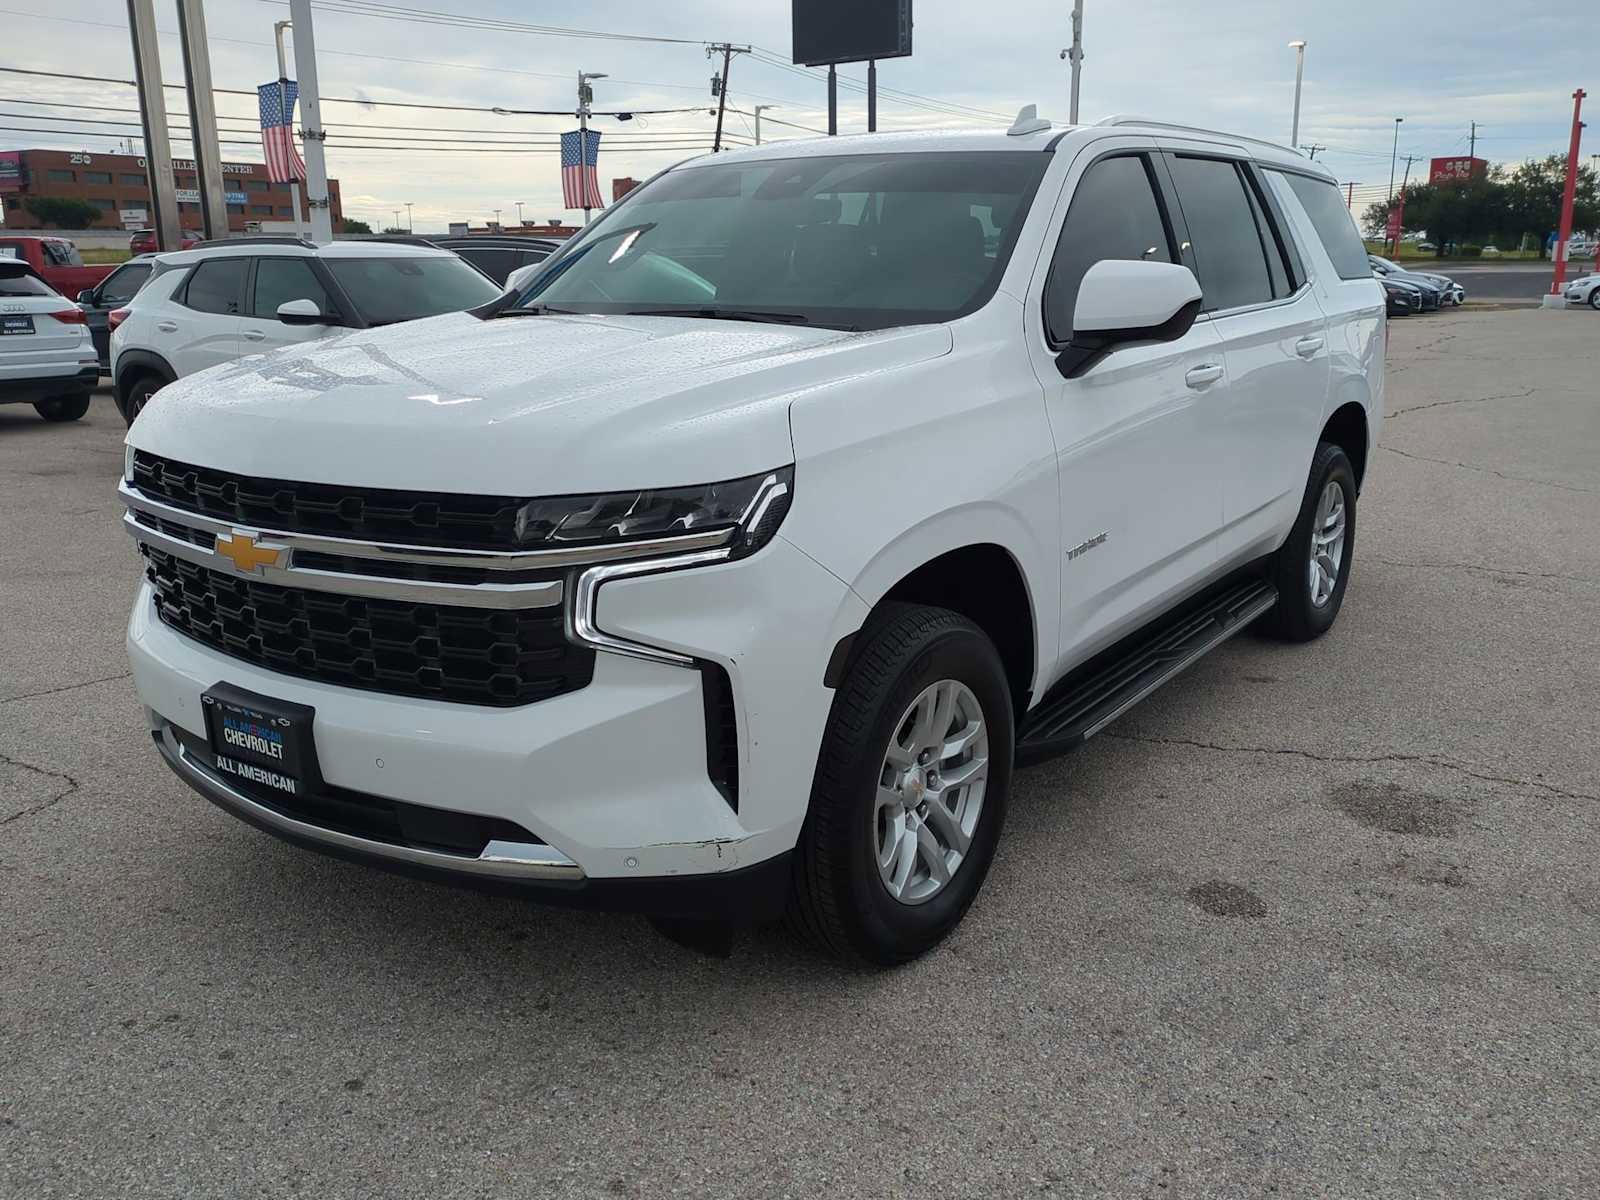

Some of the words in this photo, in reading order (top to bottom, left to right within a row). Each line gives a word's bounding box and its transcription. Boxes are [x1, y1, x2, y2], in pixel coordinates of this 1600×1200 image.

[222, 164, 253, 174] ENTER
[224, 727, 283, 760] CHEVROLET
[217, 755, 236, 774] ALL
[238, 762, 296, 794] AMERICAN
